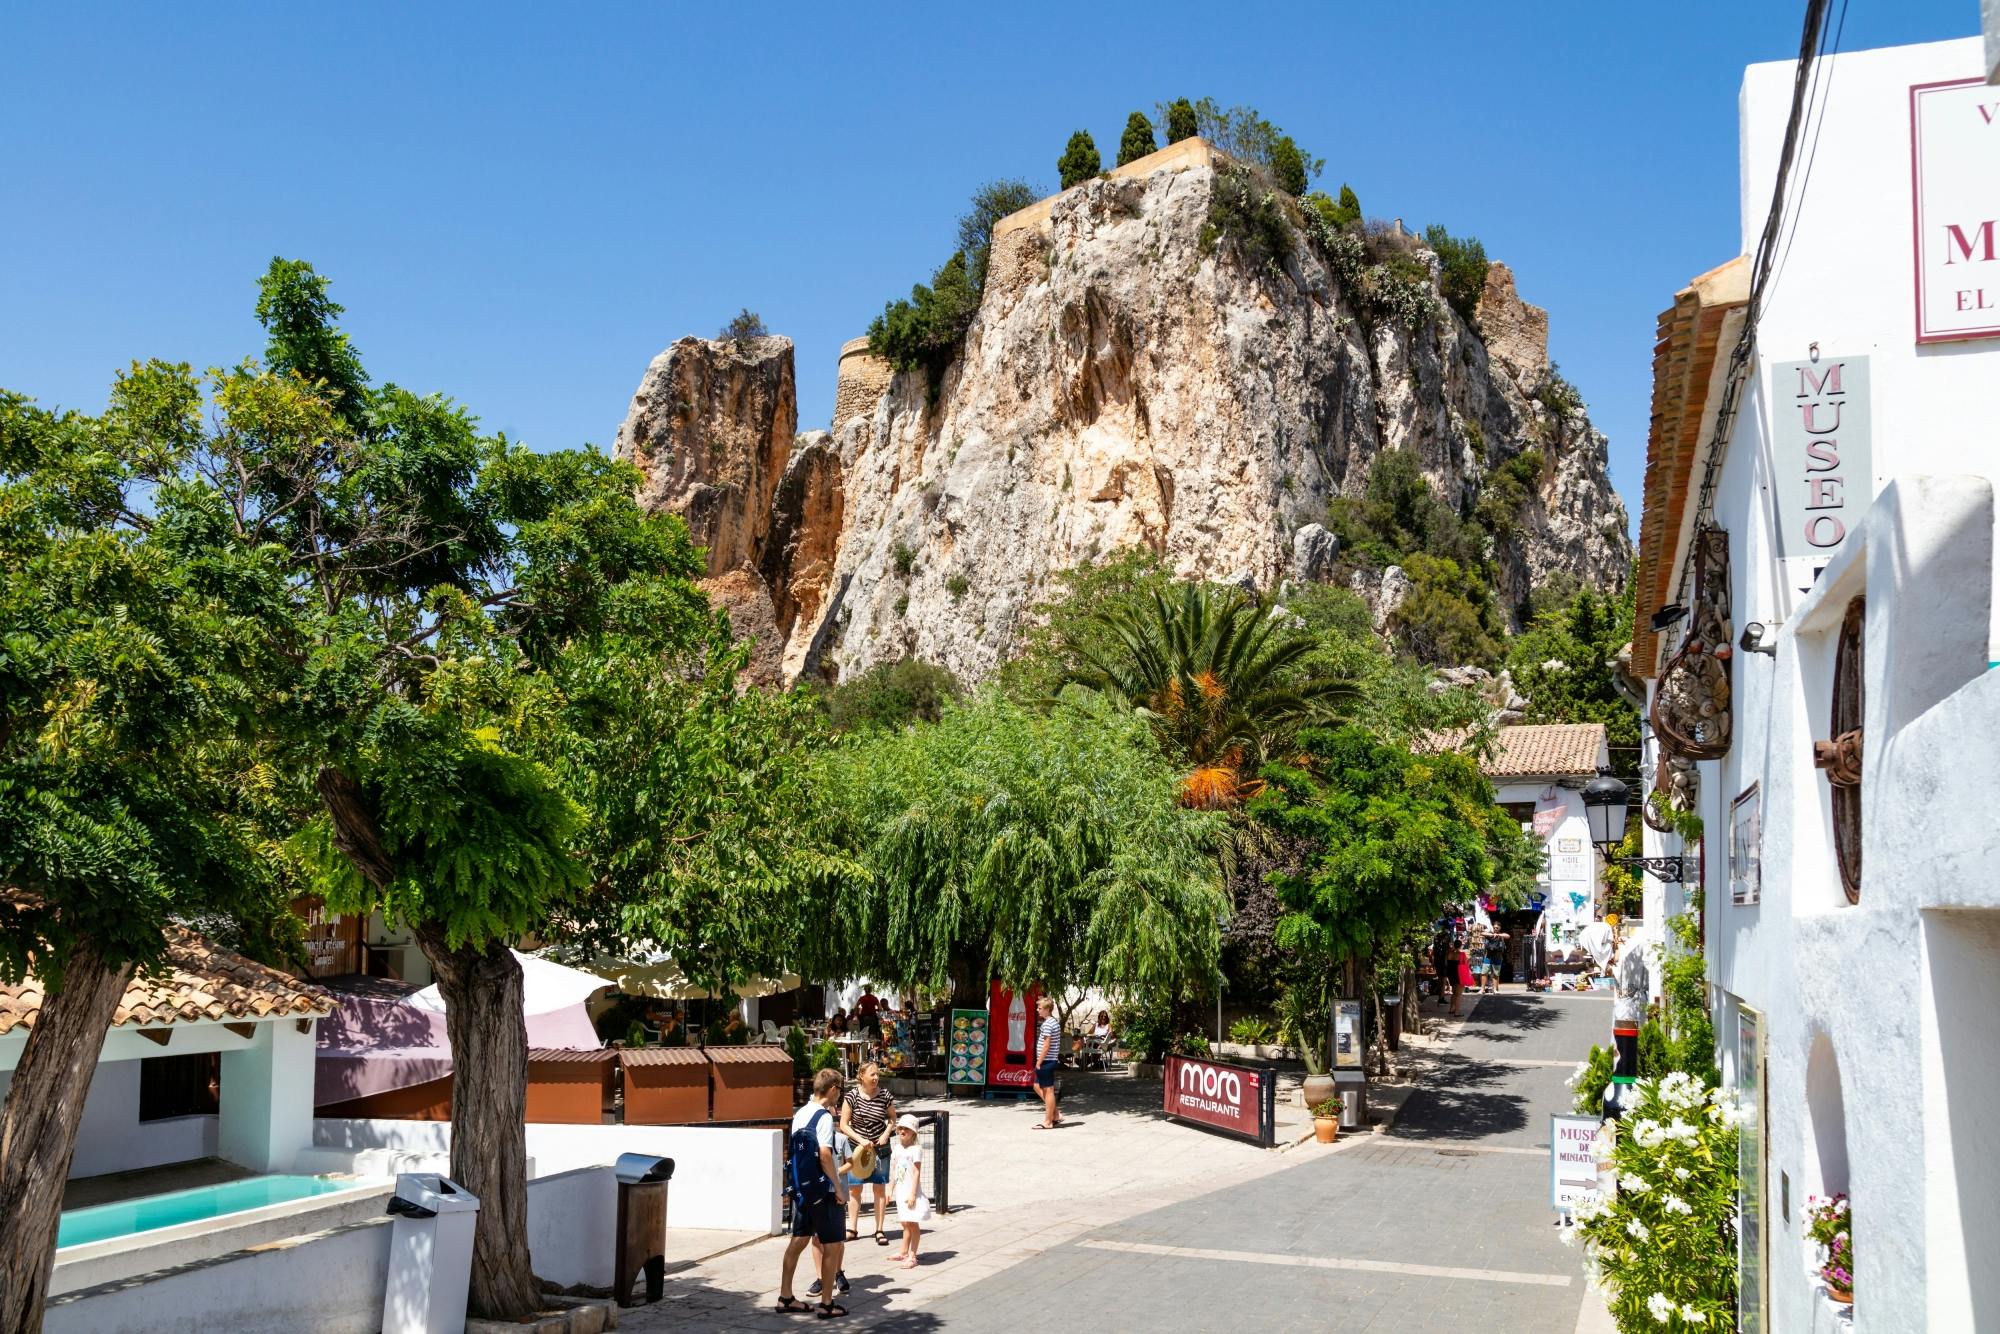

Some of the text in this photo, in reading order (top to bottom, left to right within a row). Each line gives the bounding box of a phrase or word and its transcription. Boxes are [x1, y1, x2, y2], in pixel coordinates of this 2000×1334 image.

[1955, 288, 1994, 312] EL
[1795, 363, 1846, 548] MUSEO
[996, 1069, 1032, 1082] Coca-Cola
[1180, 1062, 1240, 1105] mora
[1180, 1094, 1240, 1118] RESTAURANTE
[1559, 1153, 1597, 1163] MINIATU
[1579, 1143, 1590, 1152] DE
